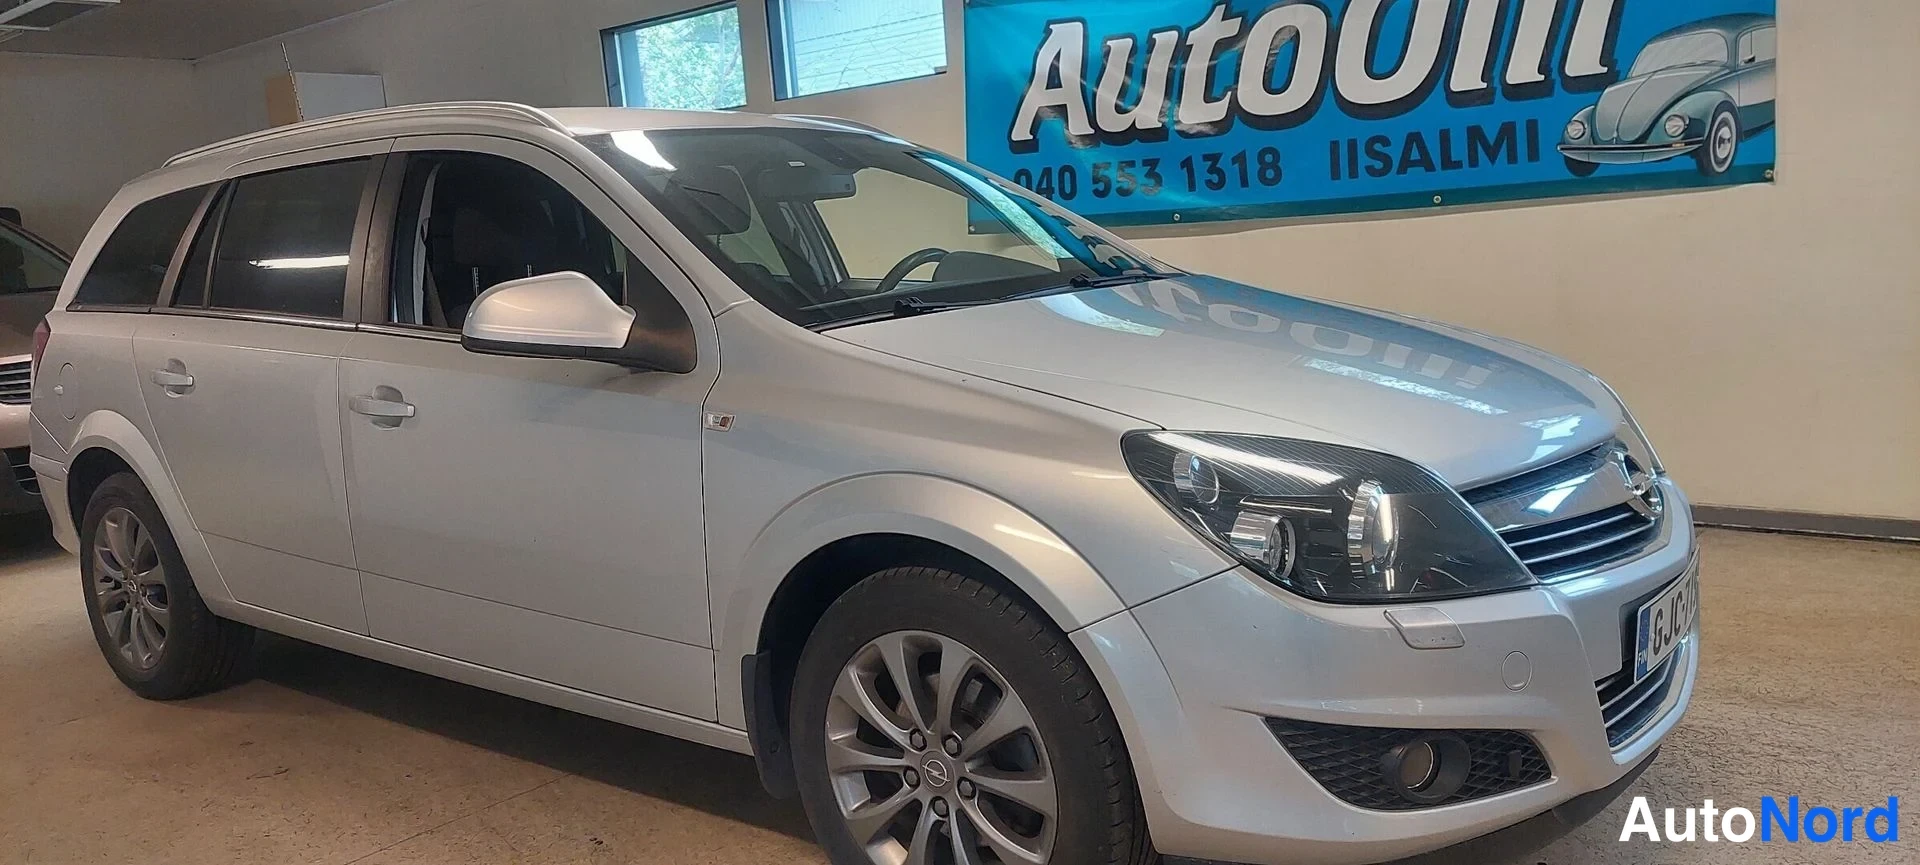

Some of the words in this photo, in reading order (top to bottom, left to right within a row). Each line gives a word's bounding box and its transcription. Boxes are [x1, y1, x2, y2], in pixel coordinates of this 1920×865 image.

[1092, 158, 1163, 198] 553
[1180, 147, 1283, 192] 1318
[1329, 119, 1540, 181] IISALMI
[1637, 649, 1648, 667] FIN
